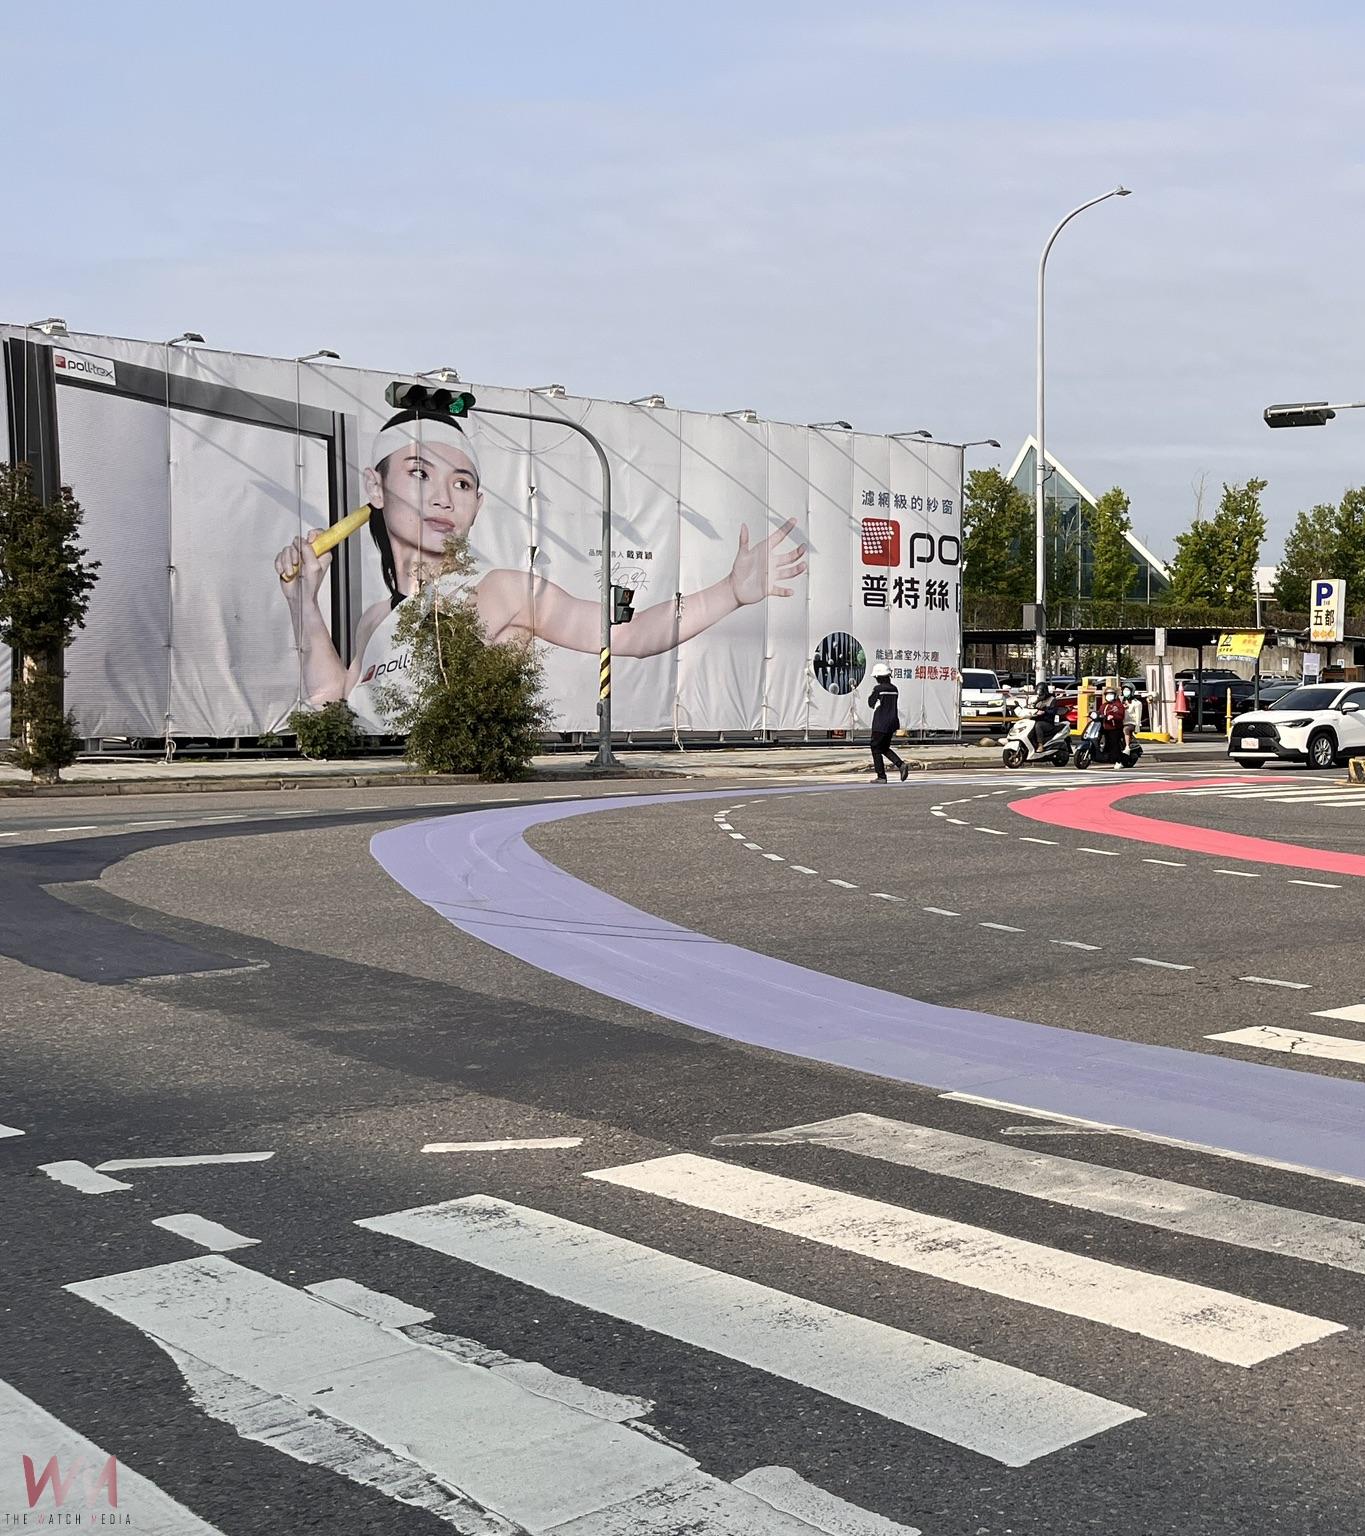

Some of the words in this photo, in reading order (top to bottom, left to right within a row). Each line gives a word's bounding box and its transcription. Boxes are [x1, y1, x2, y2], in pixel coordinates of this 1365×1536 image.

[861, 489, 953, 515] 濾網級的紗窗
[861, 574, 960, 613] 普特絲
[1316, 582, 1334, 606] P
[1313, 609, 1335, 626] 五都
